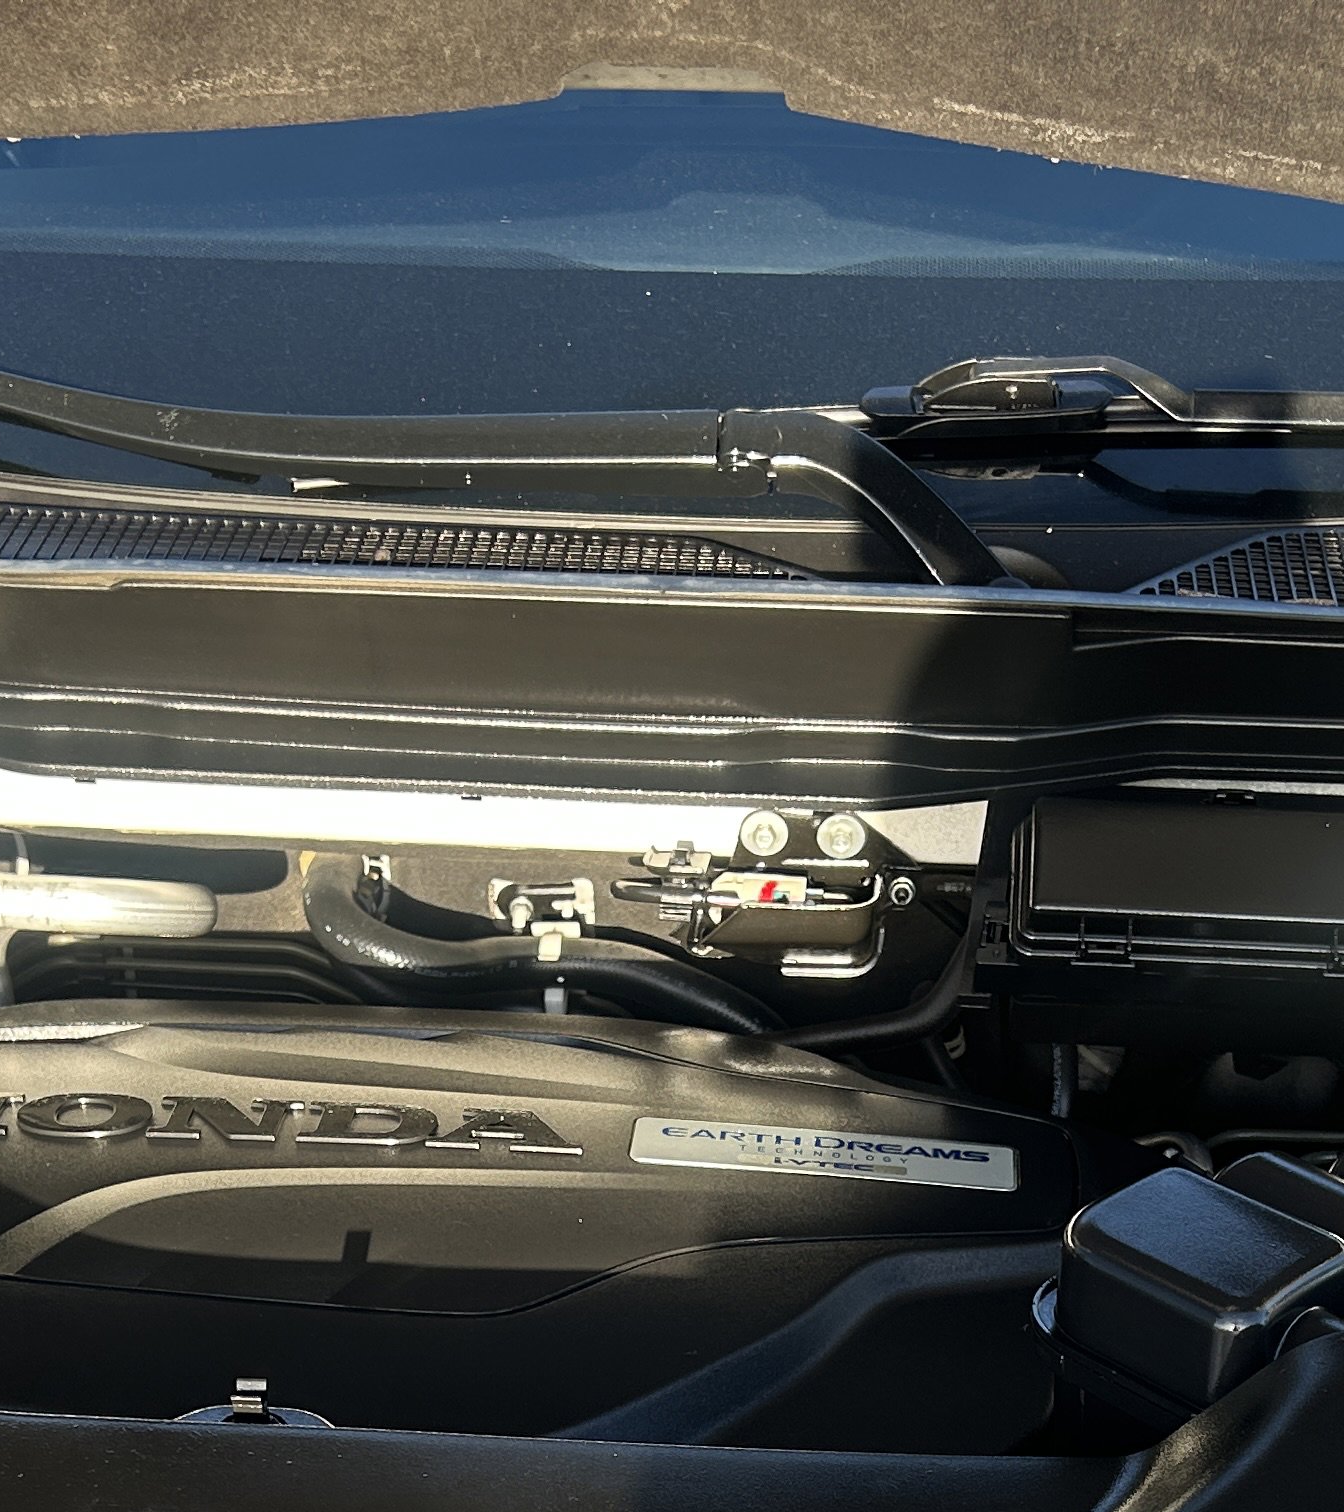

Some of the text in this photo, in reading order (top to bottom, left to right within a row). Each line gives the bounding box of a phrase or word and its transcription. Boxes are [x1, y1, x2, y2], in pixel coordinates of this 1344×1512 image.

[661, 1126, 990, 1163] EARTH DREAMS
[739, 1144, 908, 1164] TECHNOLOGY
